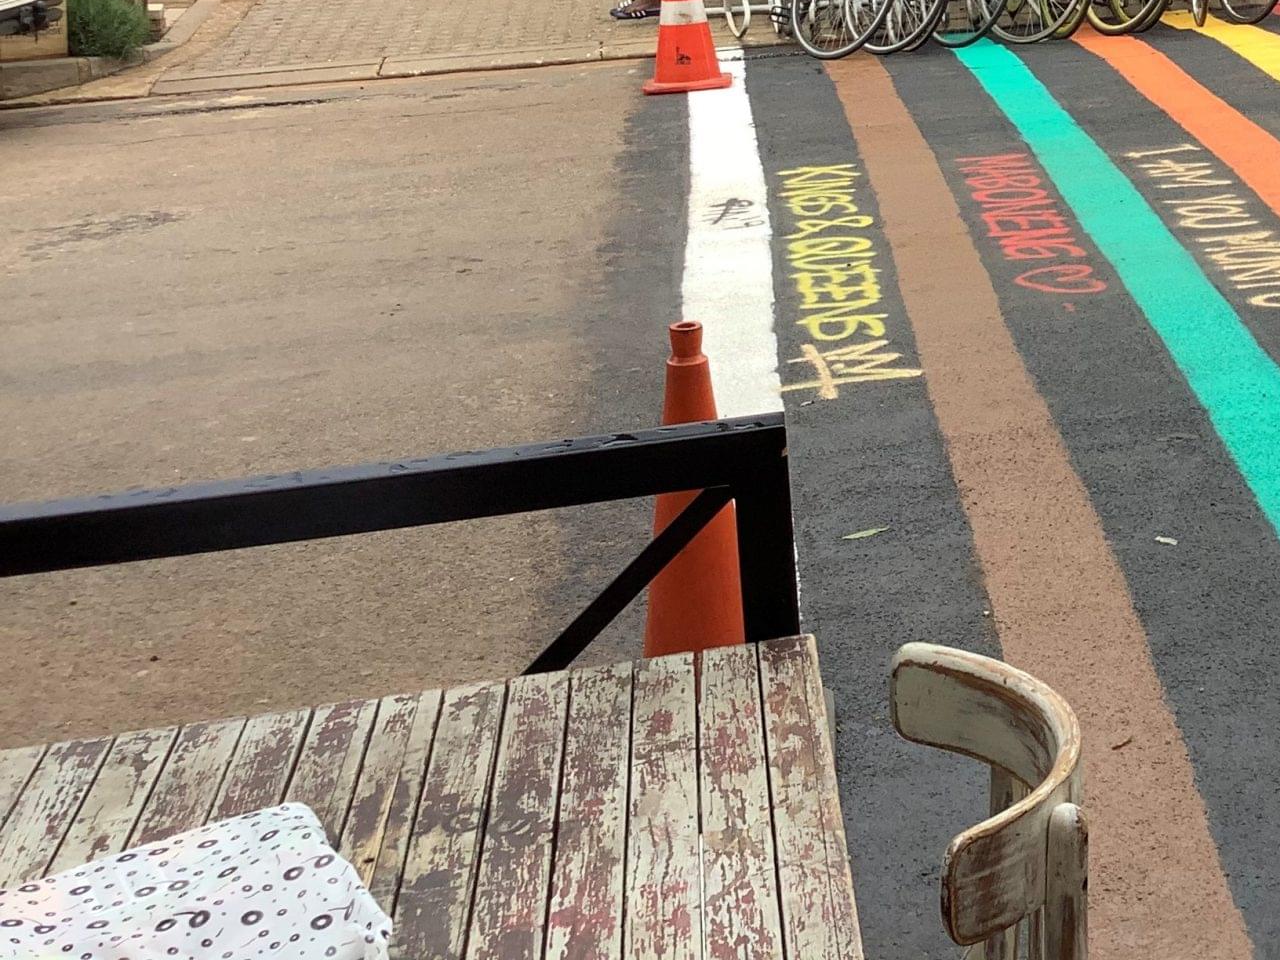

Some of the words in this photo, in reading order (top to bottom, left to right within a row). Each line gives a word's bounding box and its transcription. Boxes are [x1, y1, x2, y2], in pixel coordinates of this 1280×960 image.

[954, 150, 1088, 260] MABONENG
[1136, 159, 1233, 189] AM
[1162, 193, 1261, 229] YOU
[784, 236, 889, 342] QUEENS
